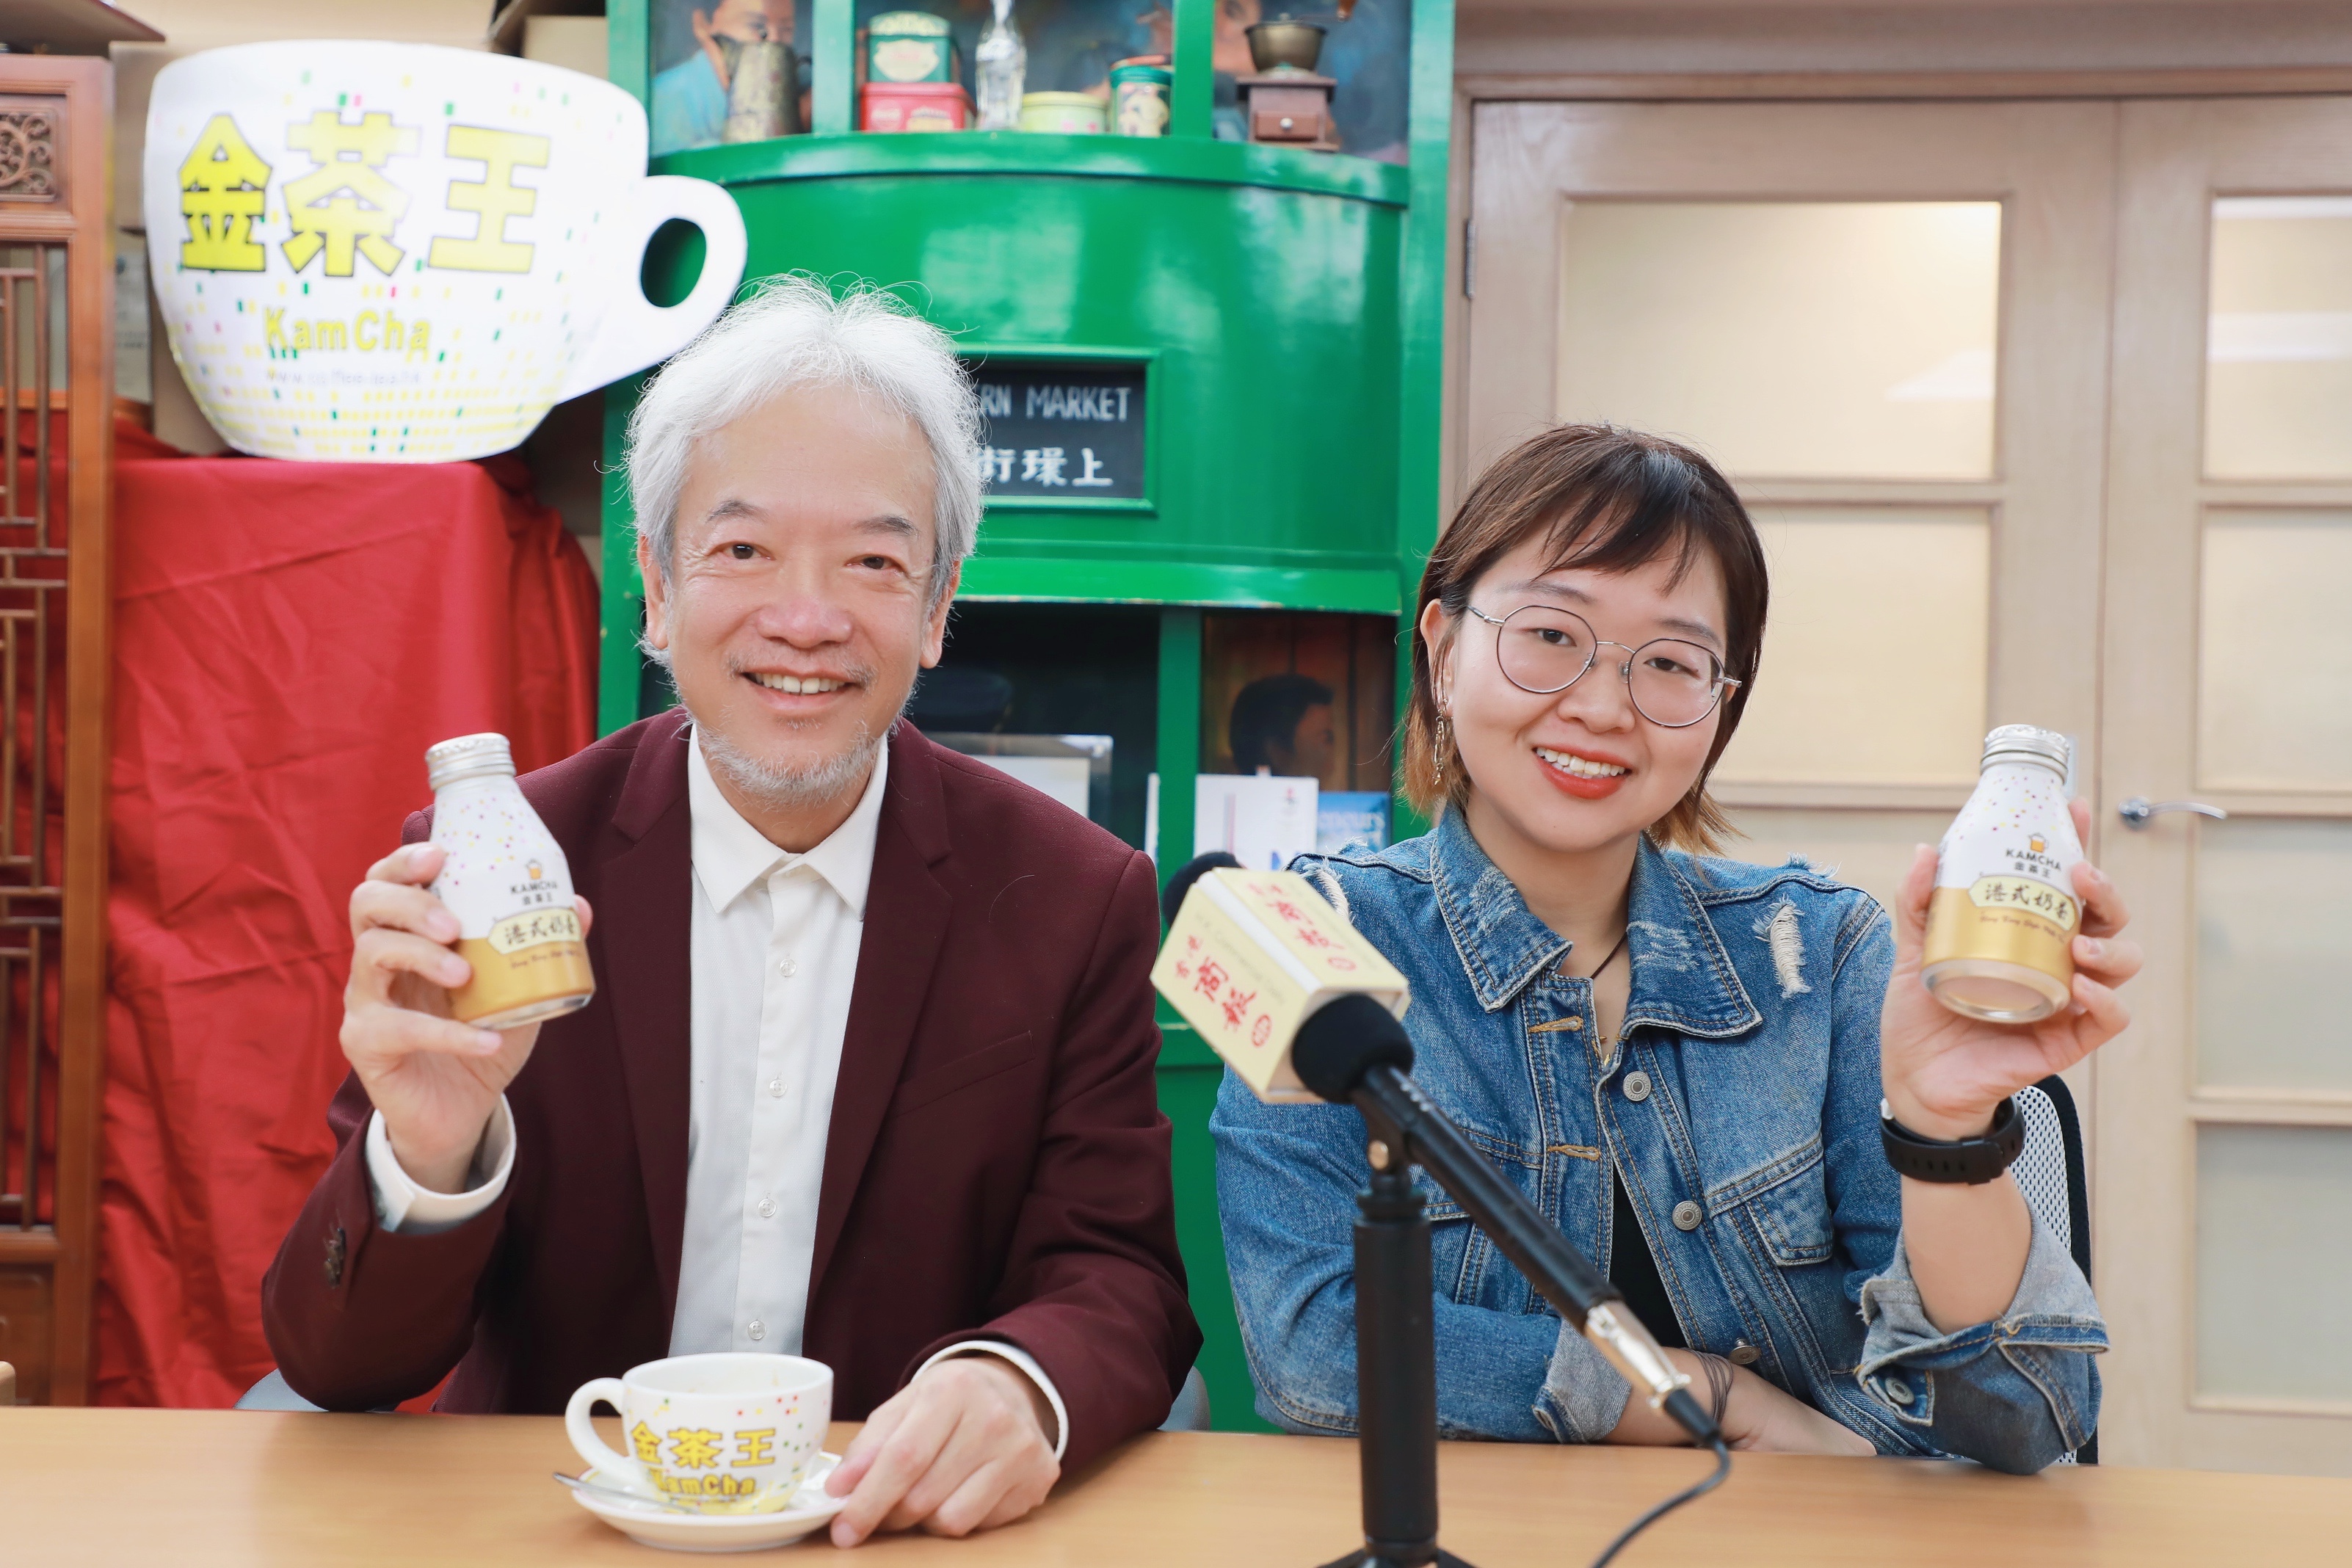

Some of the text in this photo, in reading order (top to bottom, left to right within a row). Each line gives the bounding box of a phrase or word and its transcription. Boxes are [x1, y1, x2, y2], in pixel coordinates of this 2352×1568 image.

[178, 111, 551, 277] 金茶王
[265, 306, 431, 351] KamCha
[976, 384, 1131, 422] RN MARKET
[2005, 849, 2061, 871] KAMCHA
[1985, 882, 2067, 919] 港式奶茶
[631, 1420, 776, 1469] 金茶王
